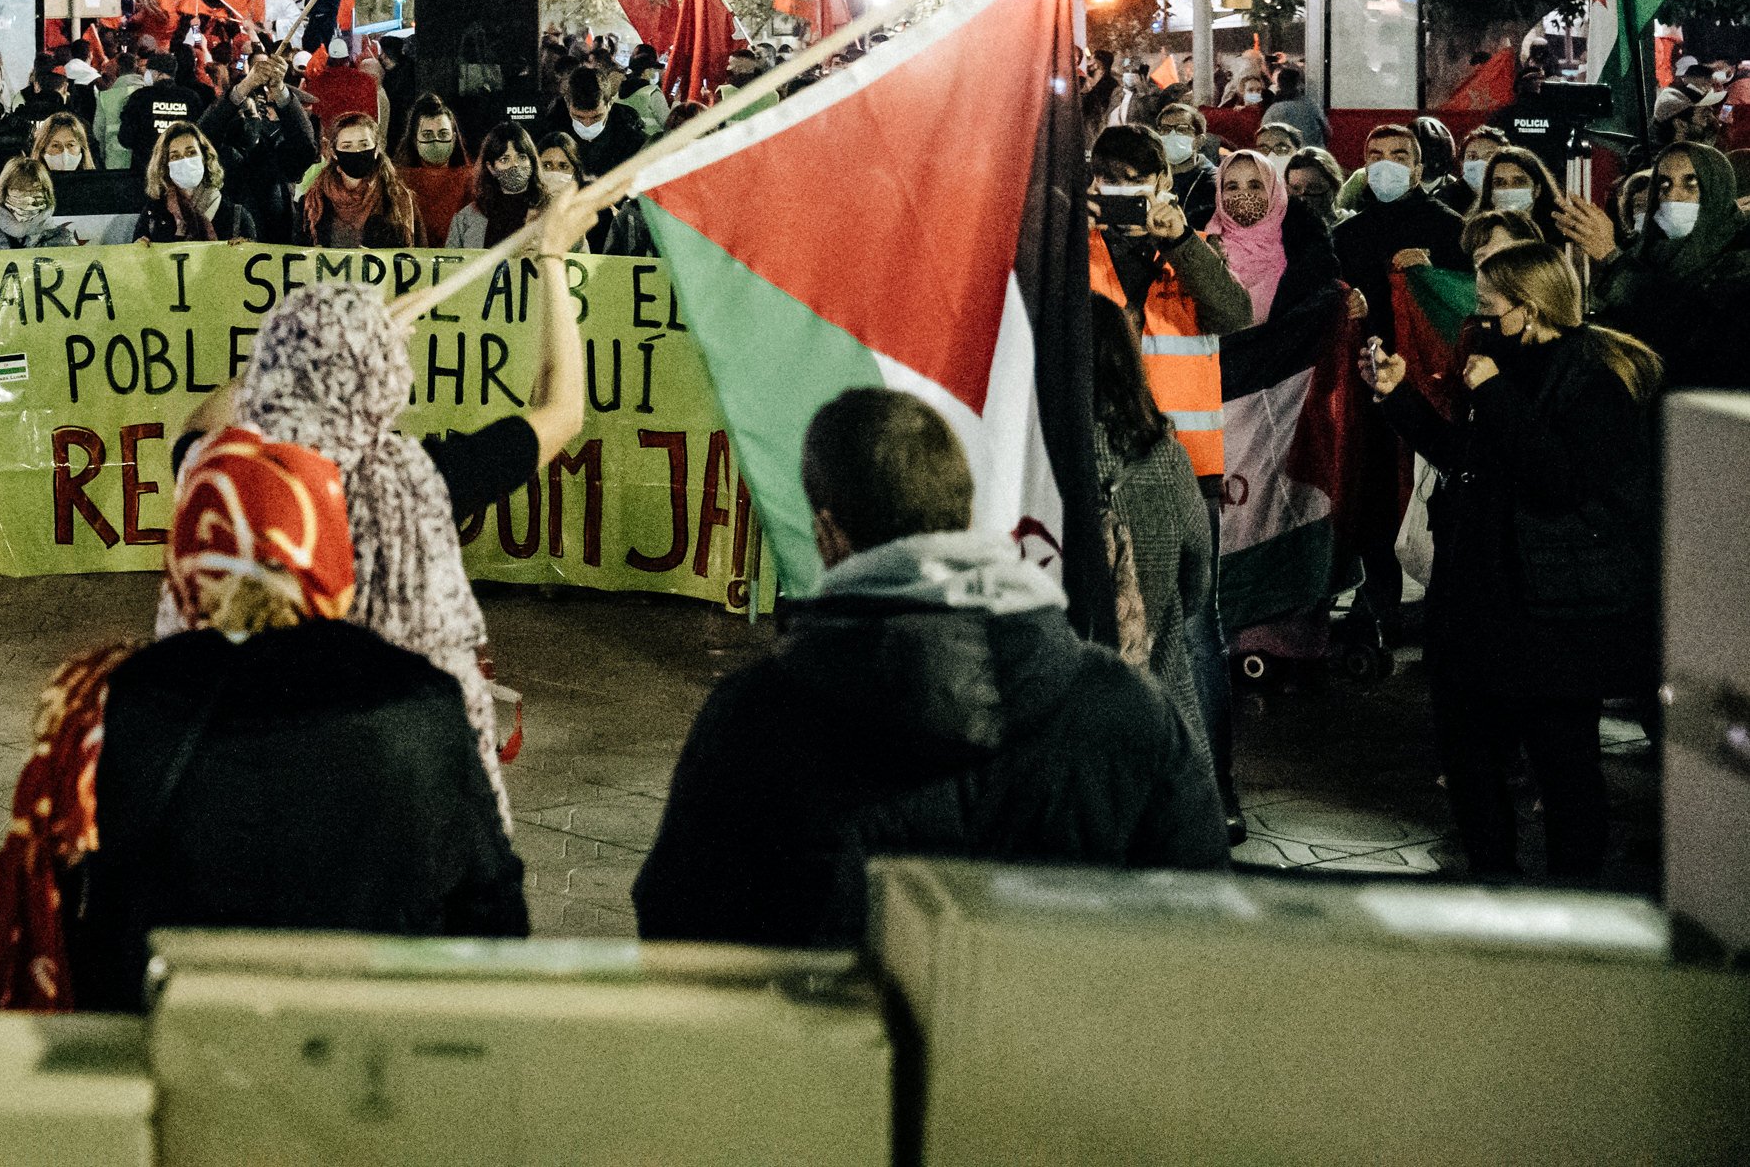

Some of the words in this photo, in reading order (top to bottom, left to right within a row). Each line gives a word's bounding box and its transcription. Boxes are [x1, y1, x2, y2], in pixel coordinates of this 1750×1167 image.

[153, 102, 187, 111] POLICIA
[507, 106, 537, 114] POLICIA
[1514, 119, 1549, 128] POLICIA
[169, 253, 191, 312] I
